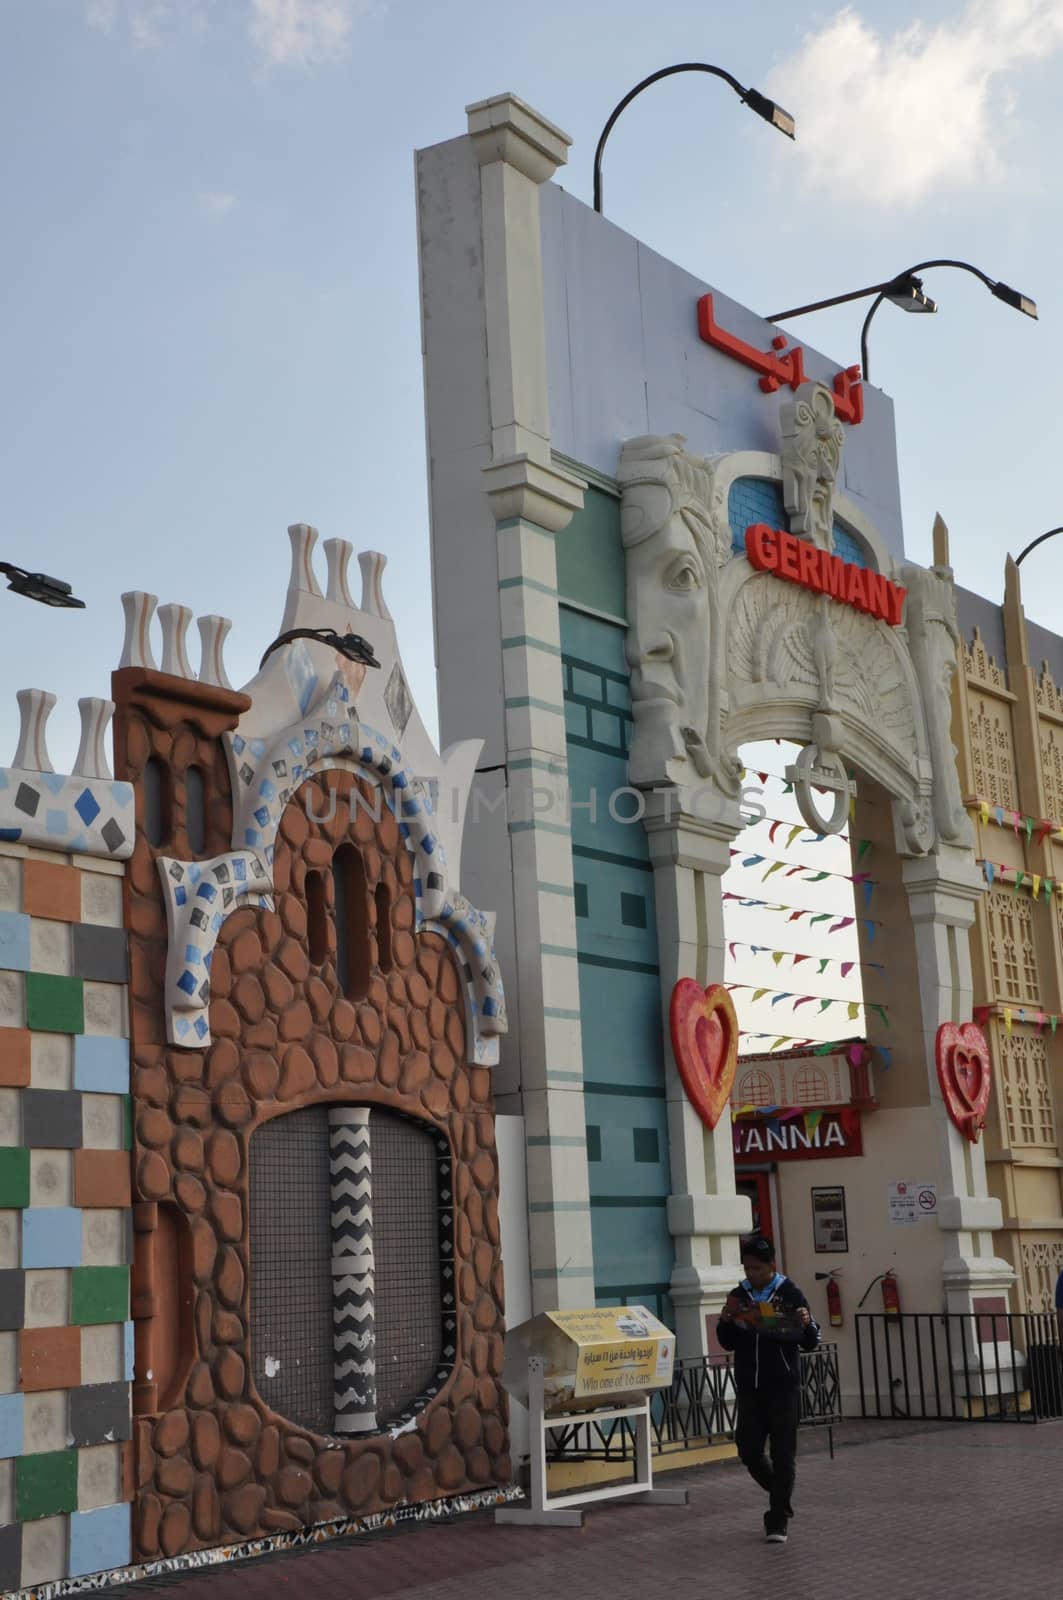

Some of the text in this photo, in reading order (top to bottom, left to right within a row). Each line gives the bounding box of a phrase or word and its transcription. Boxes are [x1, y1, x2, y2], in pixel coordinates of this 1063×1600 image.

[745, 523, 907, 628] GERMANY
[583, 1373, 651, 1392] Win one of 16 cars
